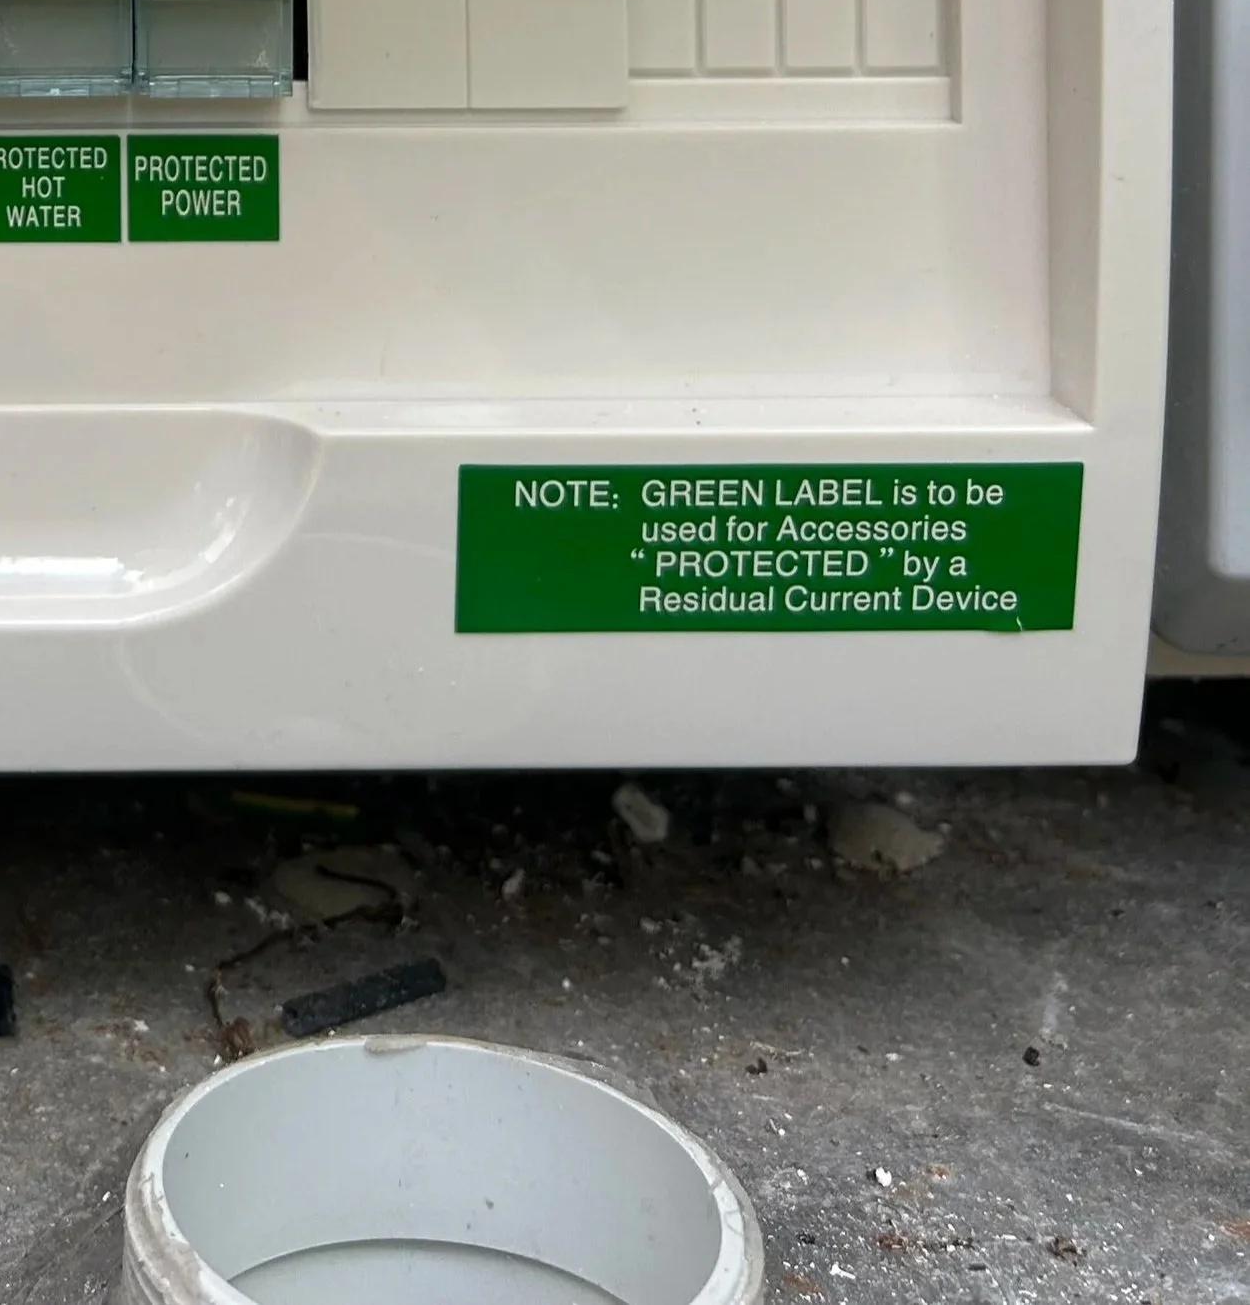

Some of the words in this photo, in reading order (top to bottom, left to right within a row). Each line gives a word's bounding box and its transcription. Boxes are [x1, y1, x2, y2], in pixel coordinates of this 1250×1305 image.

[134, 155, 269, 183] PROTECTED
[22, 176, 66, 199] HOT
[5, 205, 82, 229] WATER
[161, 189, 243, 218] POWER
[514, 480, 620, 510] NOTE:
[641, 479, 764, 509] GREEN
[775, 478, 882, 507] LABEL
[892, 479, 916, 506] is
[926, 480, 957, 507] to
[965, 479, 1004, 506] be
[641, 516, 716, 543] used
[725, 516, 769, 543] for
[776, 514, 968, 543] Accessories
[903, 550, 940, 579] by
[948, 557, 967, 577] a
[639, 586, 774, 613] Residual
[784, 585, 902, 612] Current
[911, 584, 1018, 612] Device
